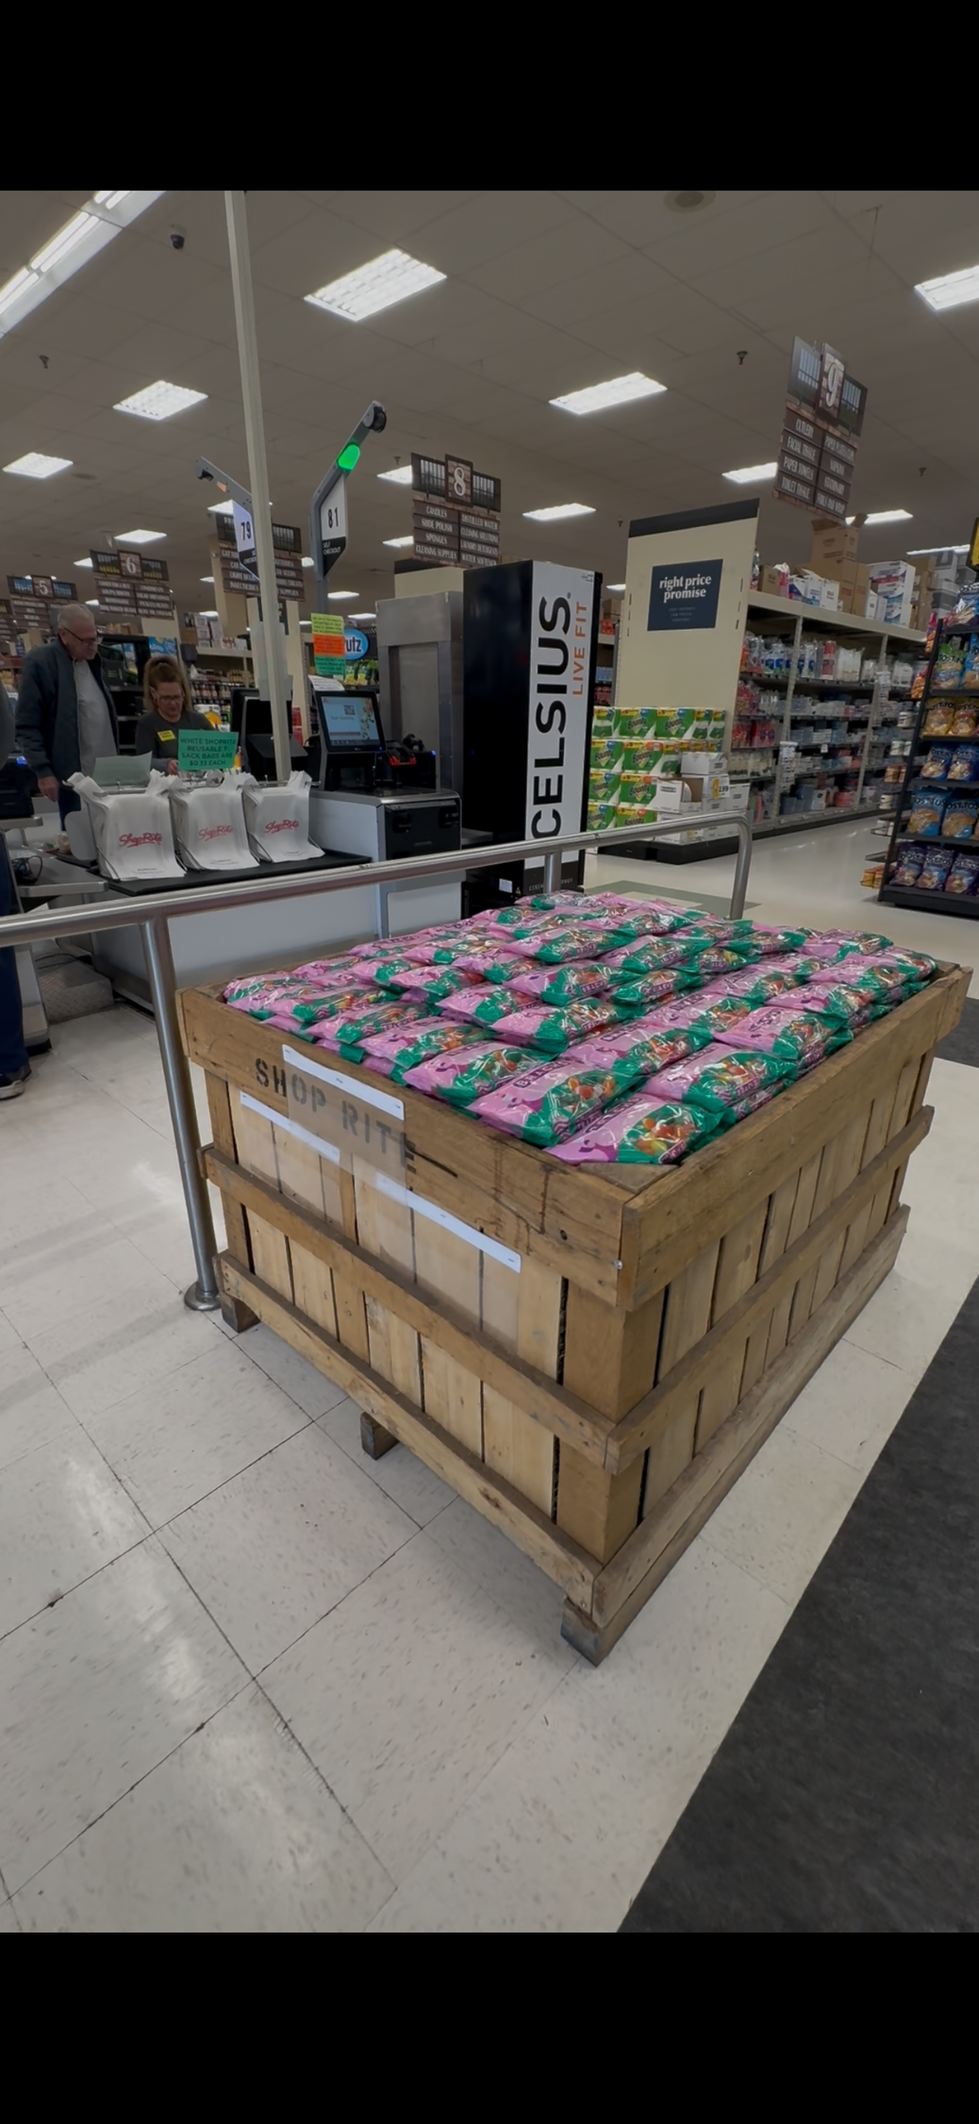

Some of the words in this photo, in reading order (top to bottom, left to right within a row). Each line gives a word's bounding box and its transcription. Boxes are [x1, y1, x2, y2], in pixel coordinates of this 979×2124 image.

[826, 362, 839, 408] 9
[453, 466, 466, 496] 8
[328, 507, 339, 529] 81
[425, 505, 448, 518] CANDLES
[240, 521, 252, 541] 79
[421, 518, 434, 529] SHOE
[435, 521, 453, 533] POLISH
[425, 532, 448, 545] SPONGES
[323, 546, 341, 555] CHECKOUT
[415, 544, 437, 556] CLEANING
[437, 548, 457, 560] SUPPLIES
[125, 556, 137, 574] 6
[39, 580, 48, 595] 5
[659, 576, 684, 591] right
[684, 573, 712, 590] price
[663, 587, 707, 604] promise
[574, 601, 587, 638] FIT
[572, 646, 585, 696] LIVE
[531, 595, 572, 840] CELSIUS
[198, 824, 234, 842] ShopRite
[263, 819, 299, 834] ShopRite
[119, 832, 163, 849] ShopRite
[255, 1057, 327, 1113] SHOP
[341, 1100, 417, 1175] RITE
